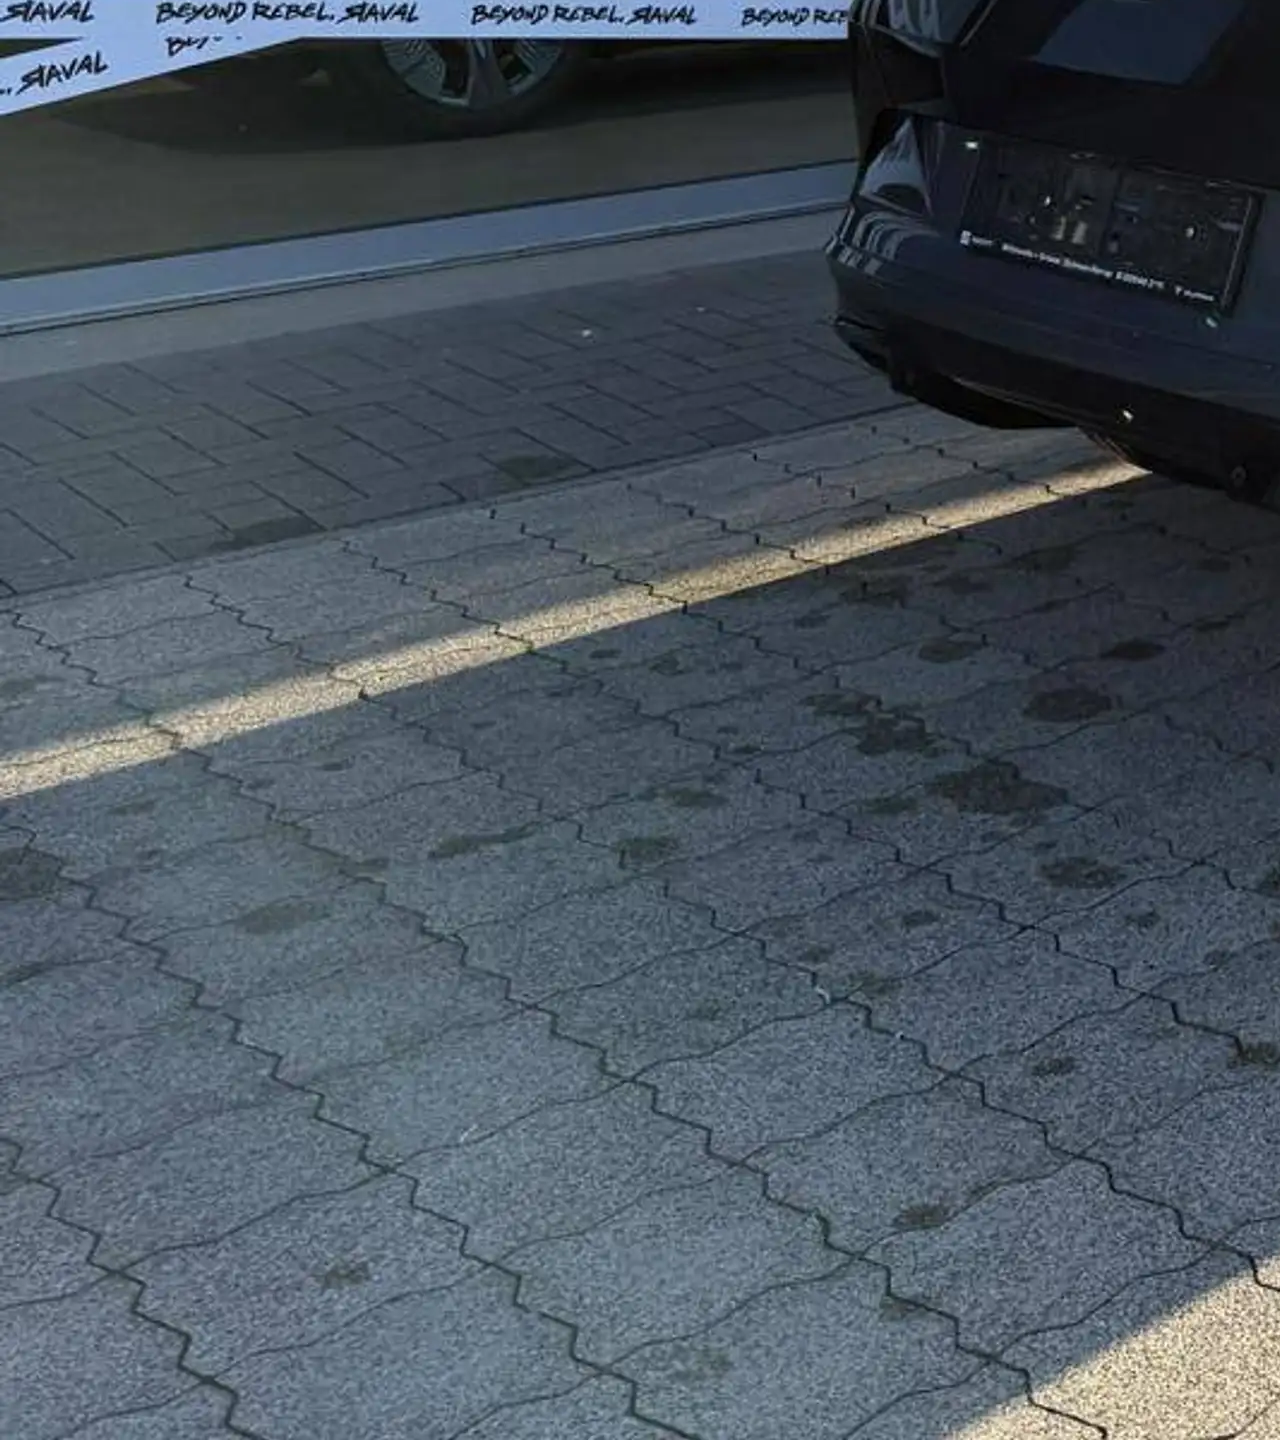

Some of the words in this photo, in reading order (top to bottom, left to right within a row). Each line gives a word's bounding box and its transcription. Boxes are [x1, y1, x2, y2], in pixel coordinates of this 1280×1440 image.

[156, 2, 246, 24] BEYOND
[251, 2, 335, 23] REBEL.
[471, 5, 549, 25] BEYOND
[552, 5, 625, 23] REBEL.
[741, 7, 810, 27] BEYOND
